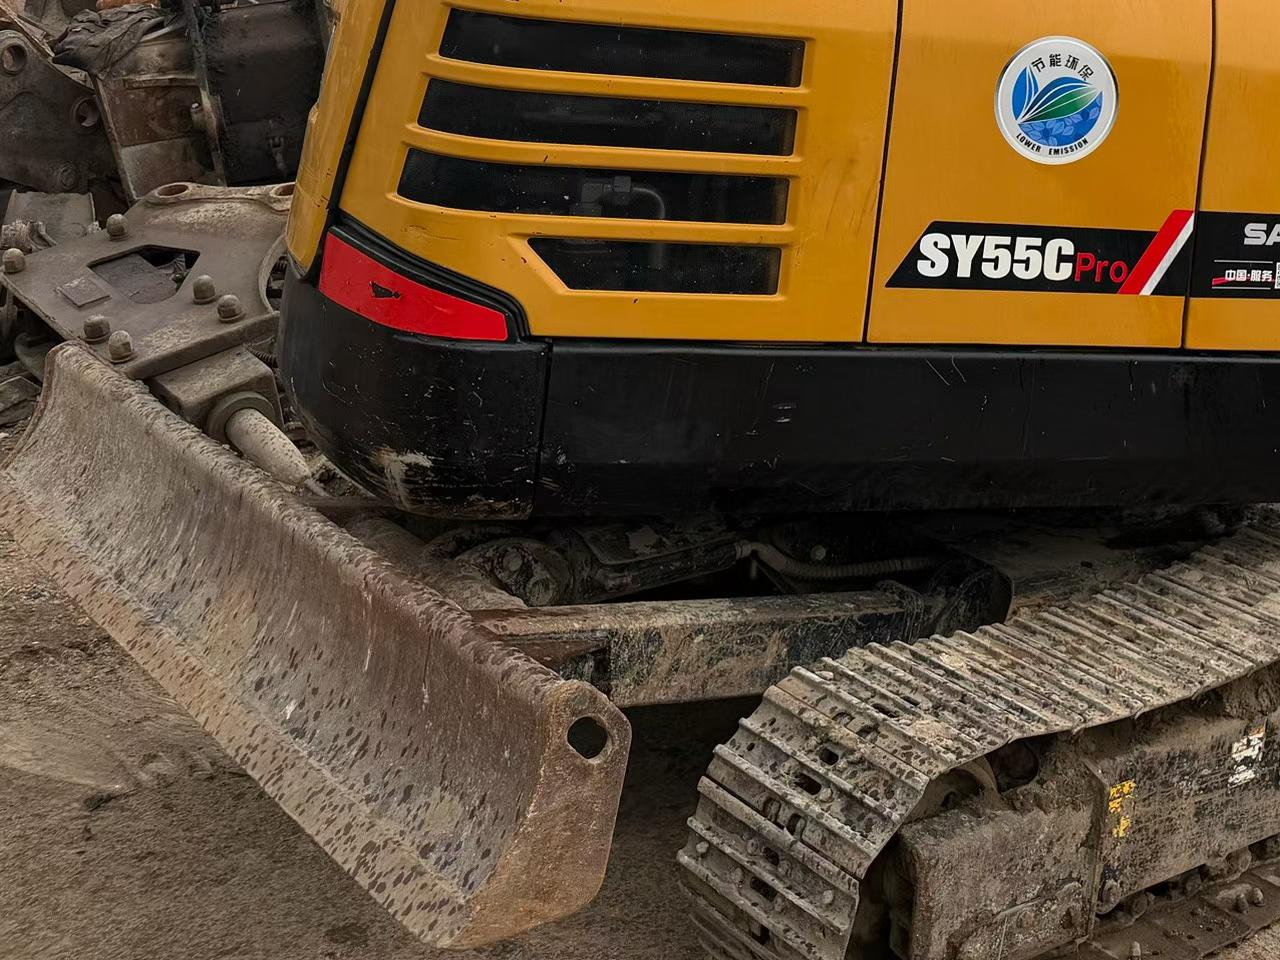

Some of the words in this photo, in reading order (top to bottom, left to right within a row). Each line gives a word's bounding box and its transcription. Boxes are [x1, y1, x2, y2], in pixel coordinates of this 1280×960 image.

[1031, 53, 1094, 81] 节能环保
[1016, 133, 1041, 153] LOWER
[1048, 138, 1089, 156] EMISSION
[1074, 252, 1129, 283] Pro
